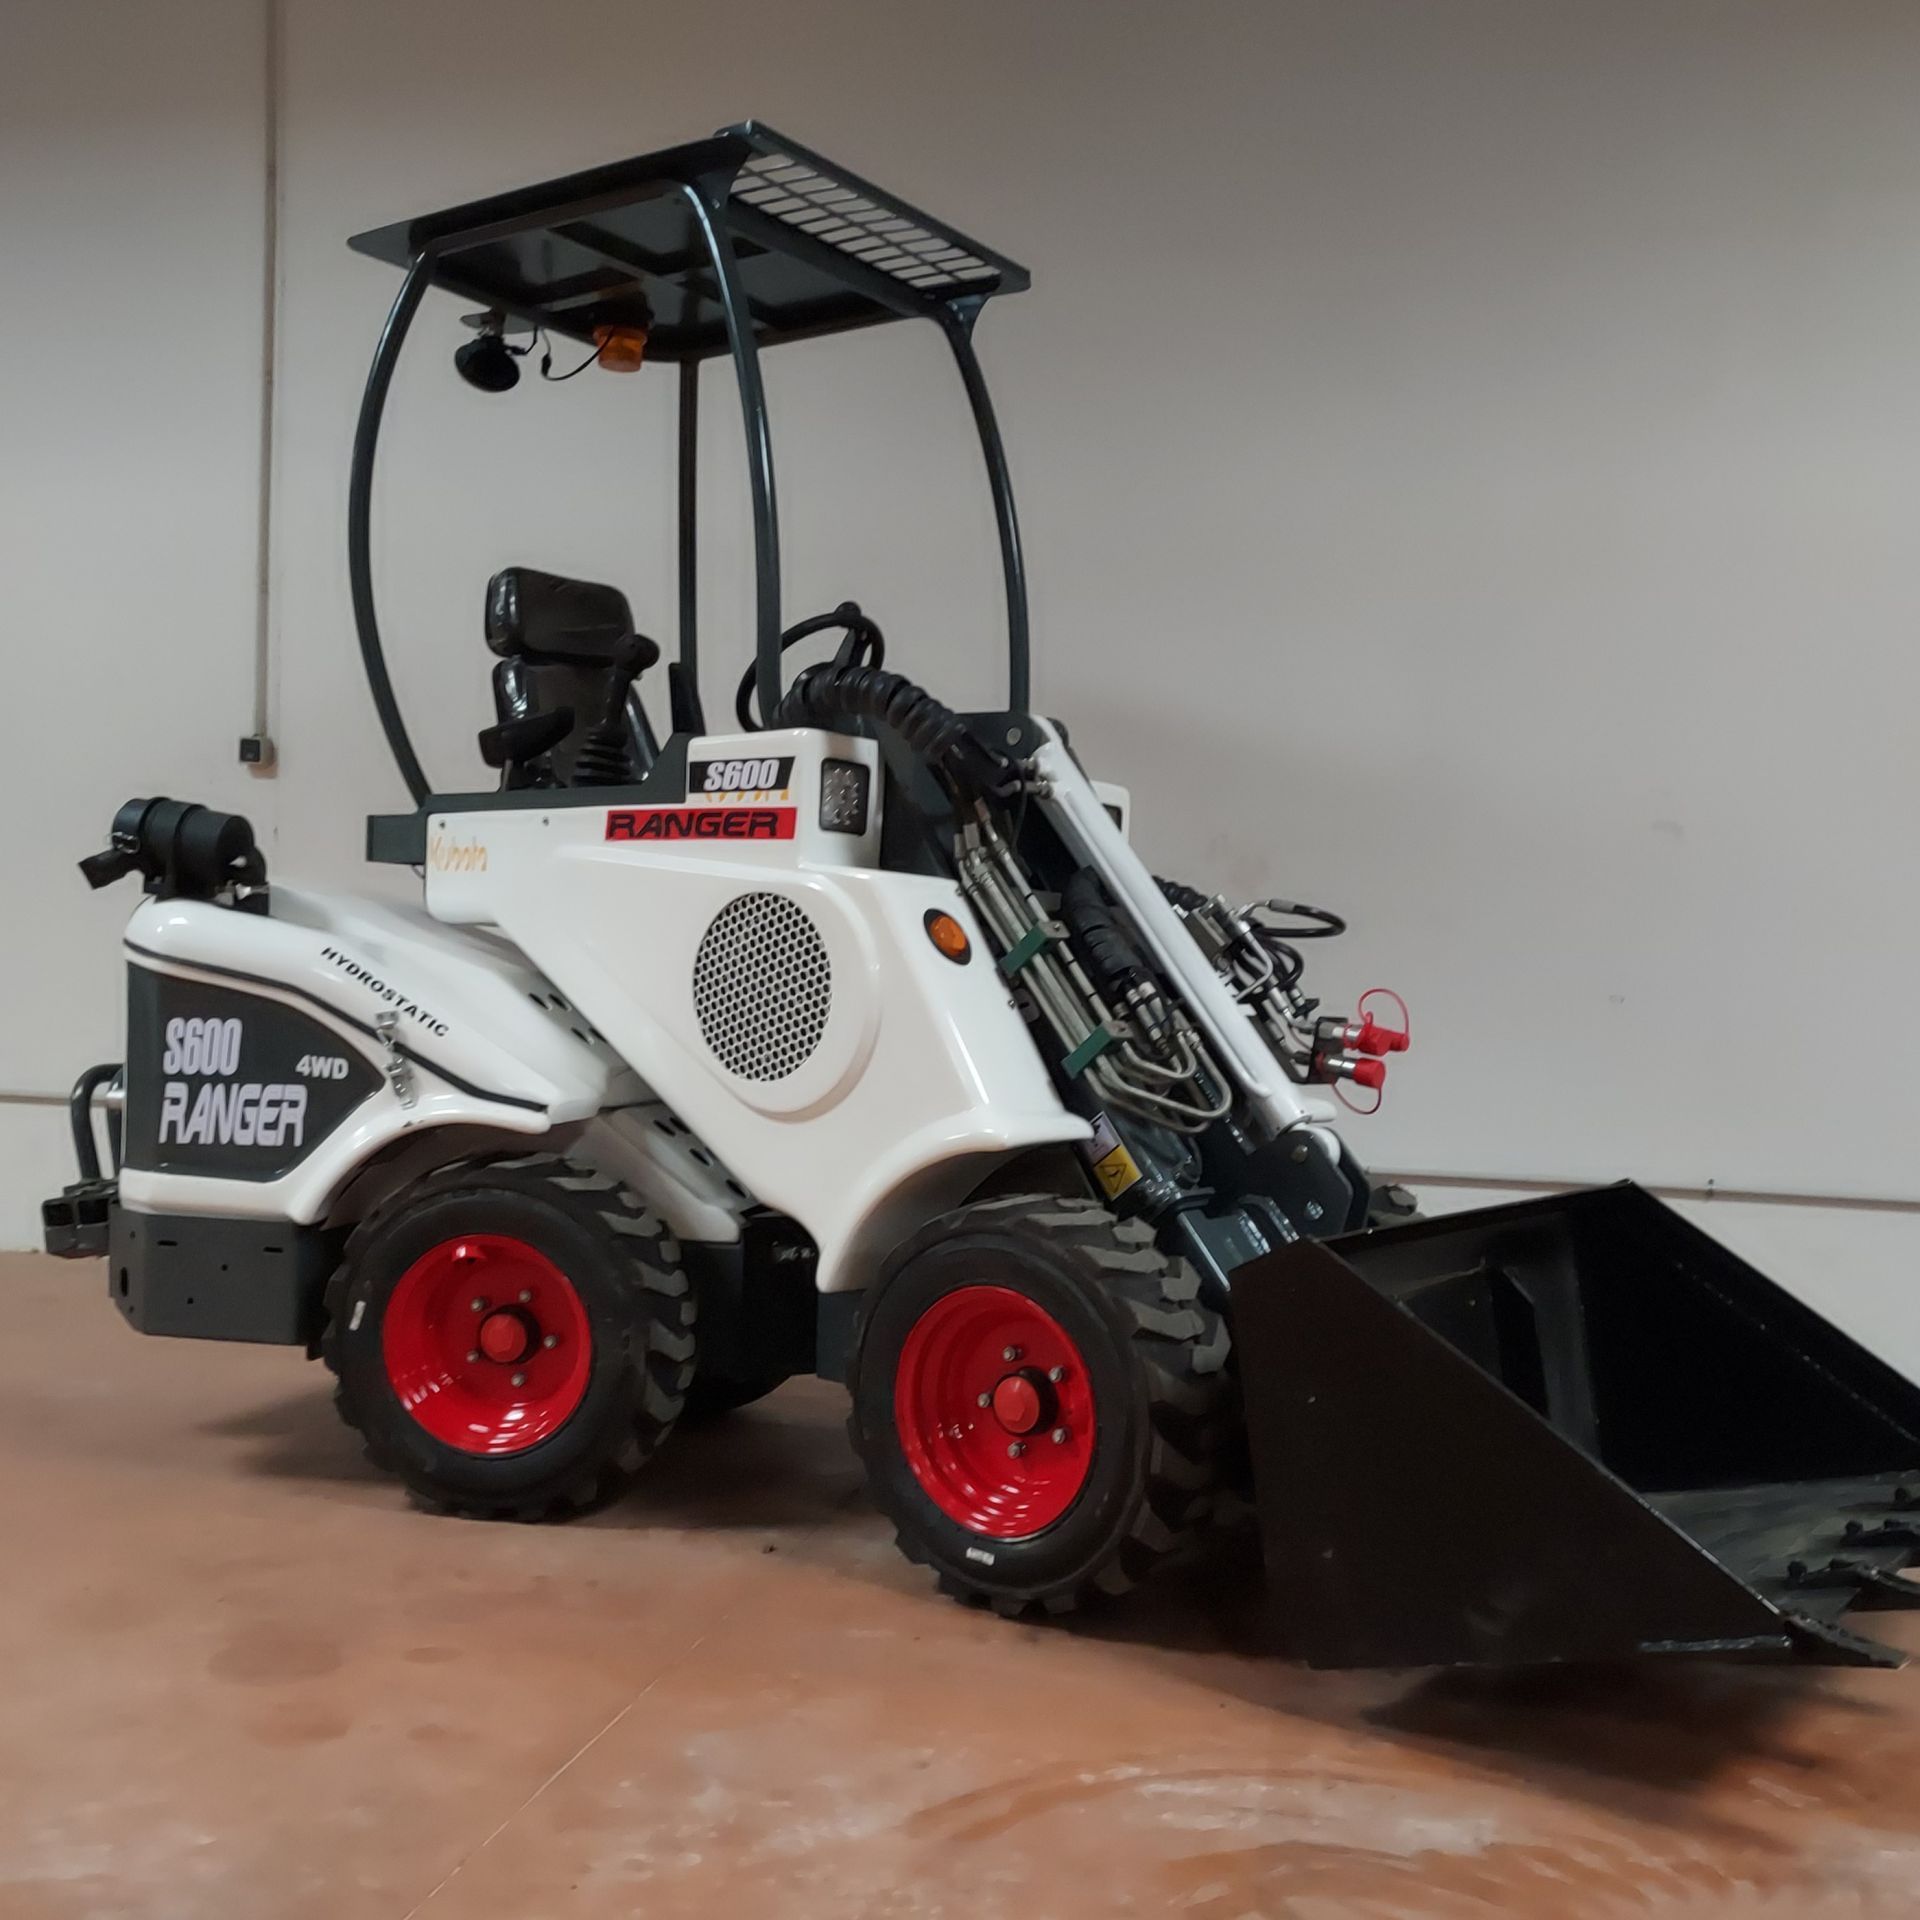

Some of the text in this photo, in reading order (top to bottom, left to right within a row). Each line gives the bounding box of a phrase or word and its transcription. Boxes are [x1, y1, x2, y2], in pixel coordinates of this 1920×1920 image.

[703, 759, 780, 791] S600
[609, 811, 779, 839] RANGER
[320, 946, 450, 1038] HYDROSTATIC
[163, 1017, 243, 1076] S600
[295, 1054, 349, 1080] 4WD
[158, 1081, 308, 1147] RANGER
